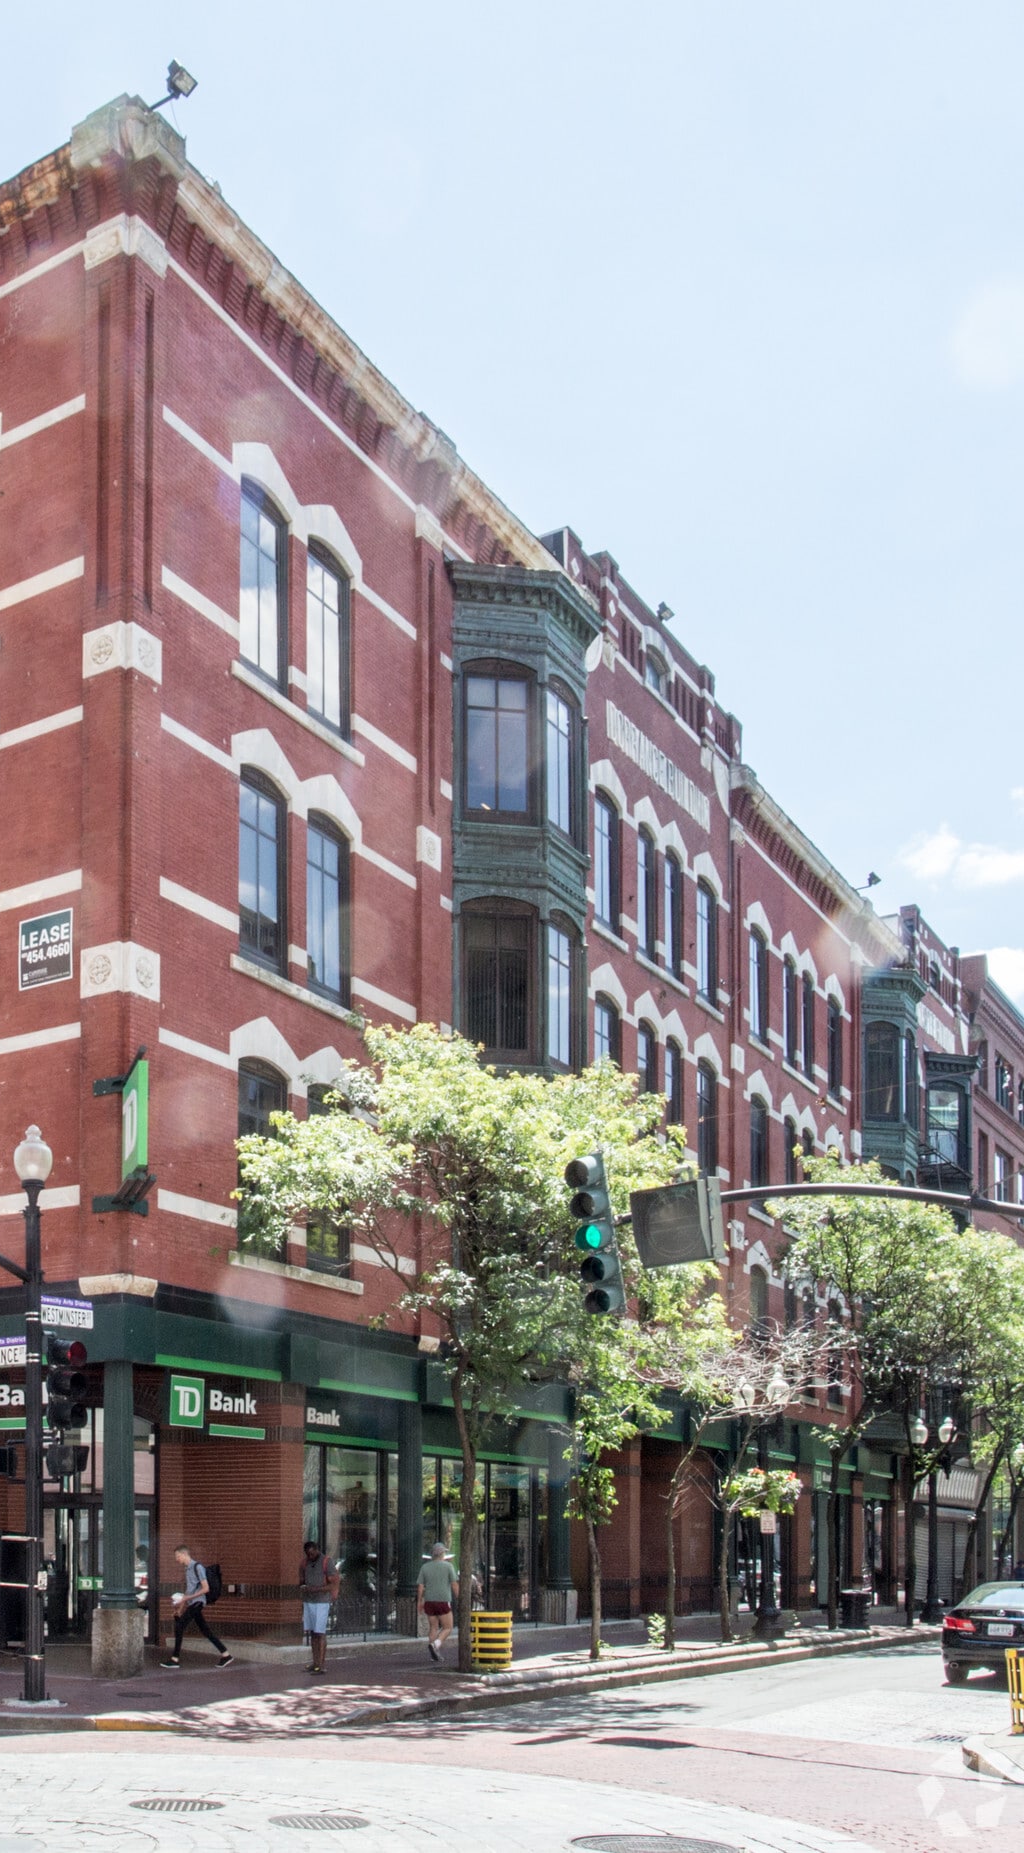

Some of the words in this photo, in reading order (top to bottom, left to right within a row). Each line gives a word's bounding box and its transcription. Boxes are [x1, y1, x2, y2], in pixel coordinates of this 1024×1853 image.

[21, 922, 70, 951] LEASE
[41, 1307, 86, 1326] WESTMINSTER
[6, 1336, 26, 1344] District
[174, 1385, 201, 1418] TD
[209, 1389, 257, 1415] Bank
[306, 1407, 341, 1427] Bank
